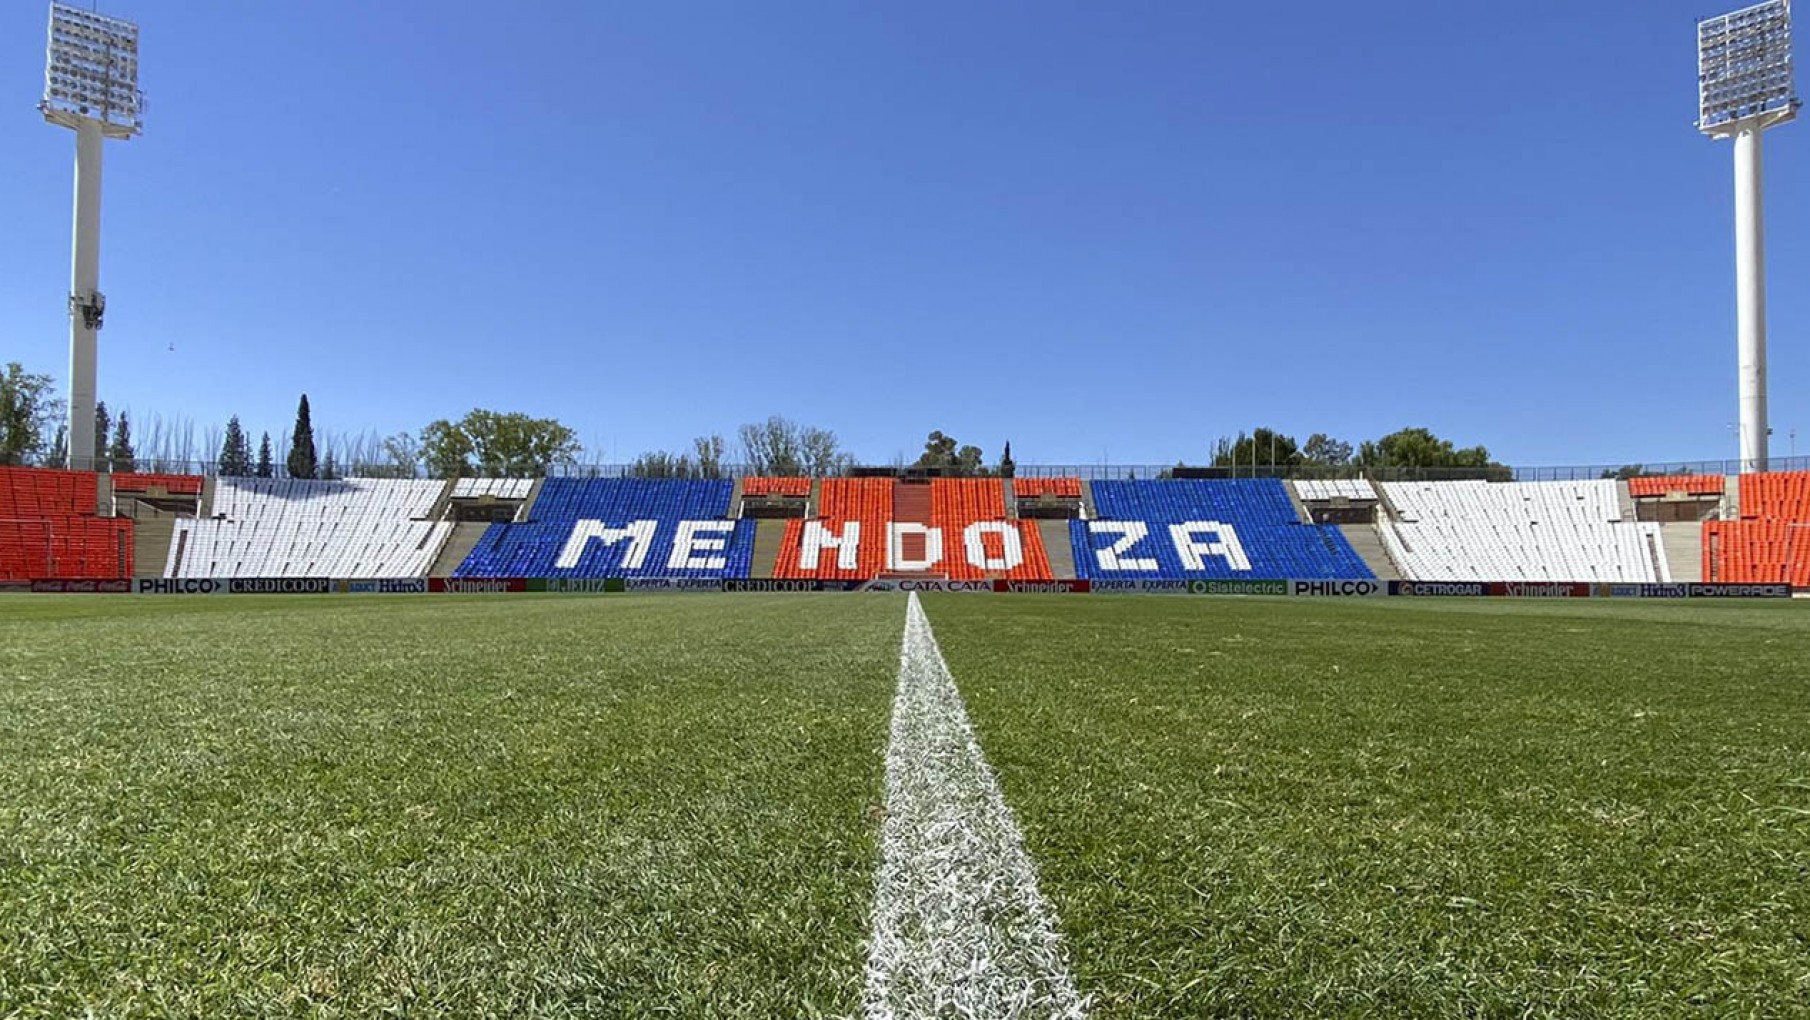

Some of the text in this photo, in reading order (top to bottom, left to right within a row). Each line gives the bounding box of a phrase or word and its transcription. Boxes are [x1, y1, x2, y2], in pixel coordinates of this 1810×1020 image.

[556, 519, 1252, 573] MENDOZA
[139, 579, 213, 593] PHILCO
[231, 579, 328, 592] CREDICOOP
[443, 578, 511, 593] Schneider
[626, 579, 722, 589] EXPERTA EXPERTA
[724, 580, 817, 592] CREDICOOP
[899, 581, 942, 592] CATA
[947, 581, 991, 592] CATA
[1007, 580, 1074, 593] Schneider
[1092, 580, 1187, 591] EXPERTA EXPERTA
[1208, 581, 1284, 593] Sistelectric
[1295, 581, 1370, 595] PHILCO
[1415, 584, 1482, 595] CETROGAR
[1505, 582, 1574, 597] Schneider
[1691, 585, 1787, 596] POWERADE
